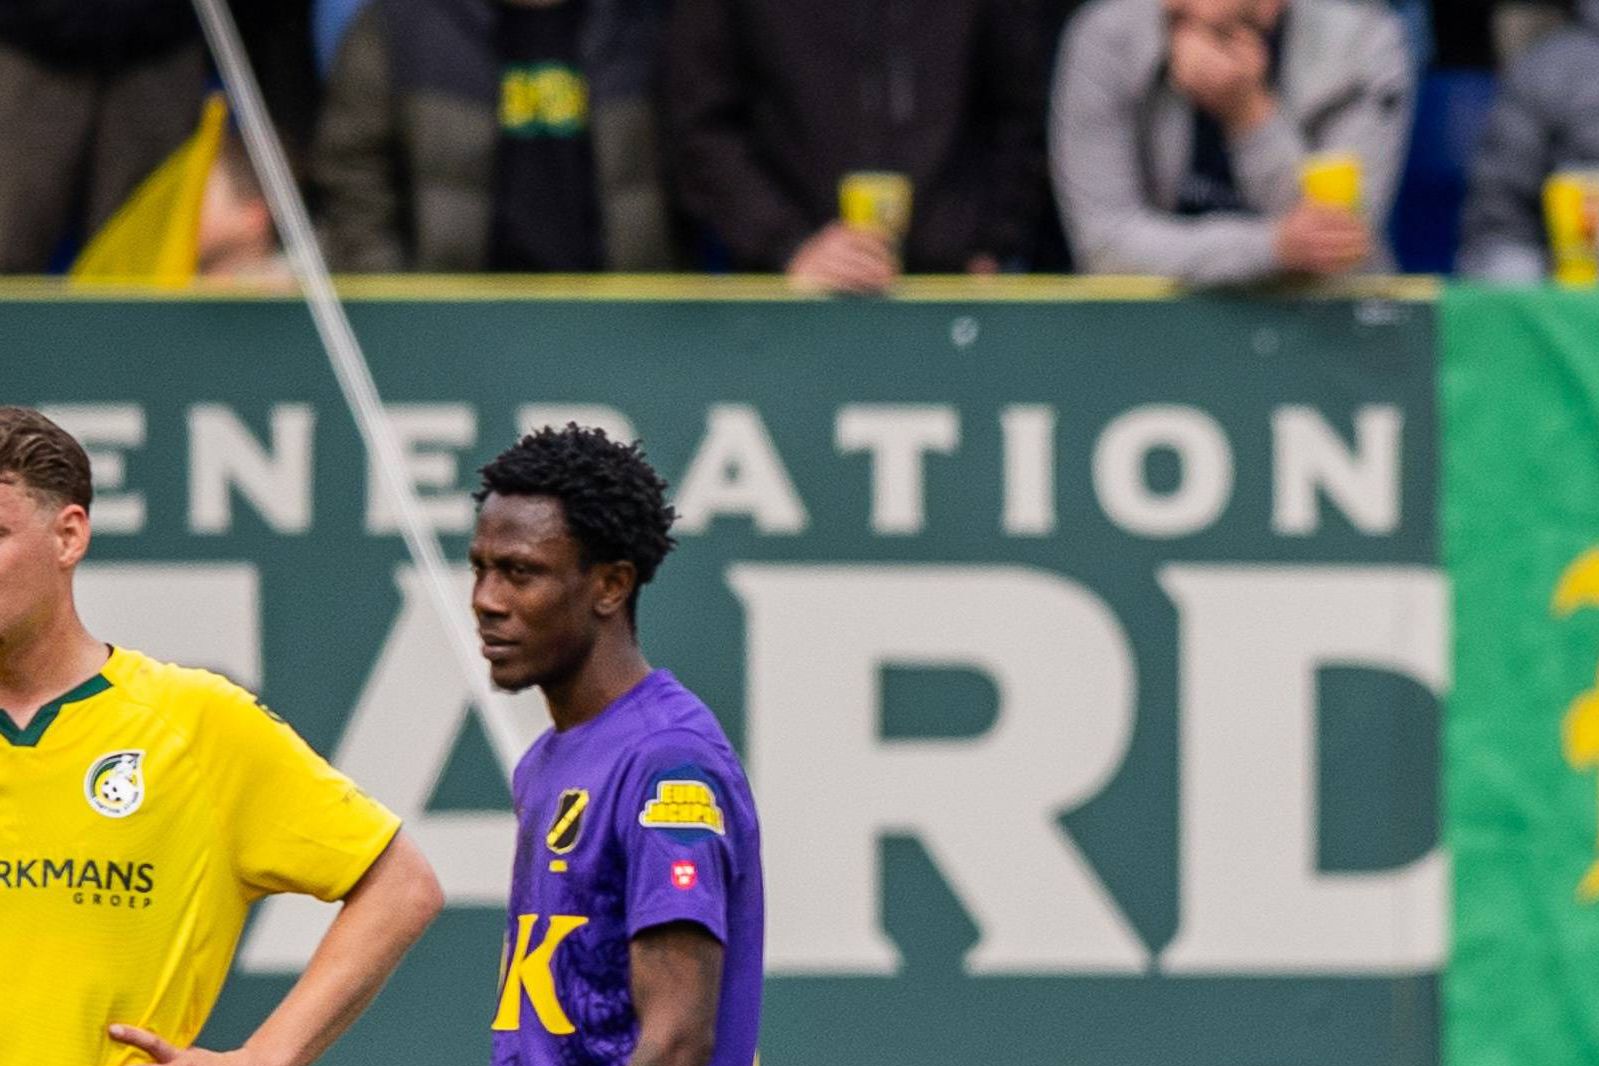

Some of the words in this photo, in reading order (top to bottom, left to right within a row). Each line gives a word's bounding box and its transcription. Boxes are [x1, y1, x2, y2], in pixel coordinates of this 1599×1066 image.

[44, 403, 1400, 538] ENEATION
[0, 859, 154, 893] RKMANS
[73, 892, 152, 908] GROEP
